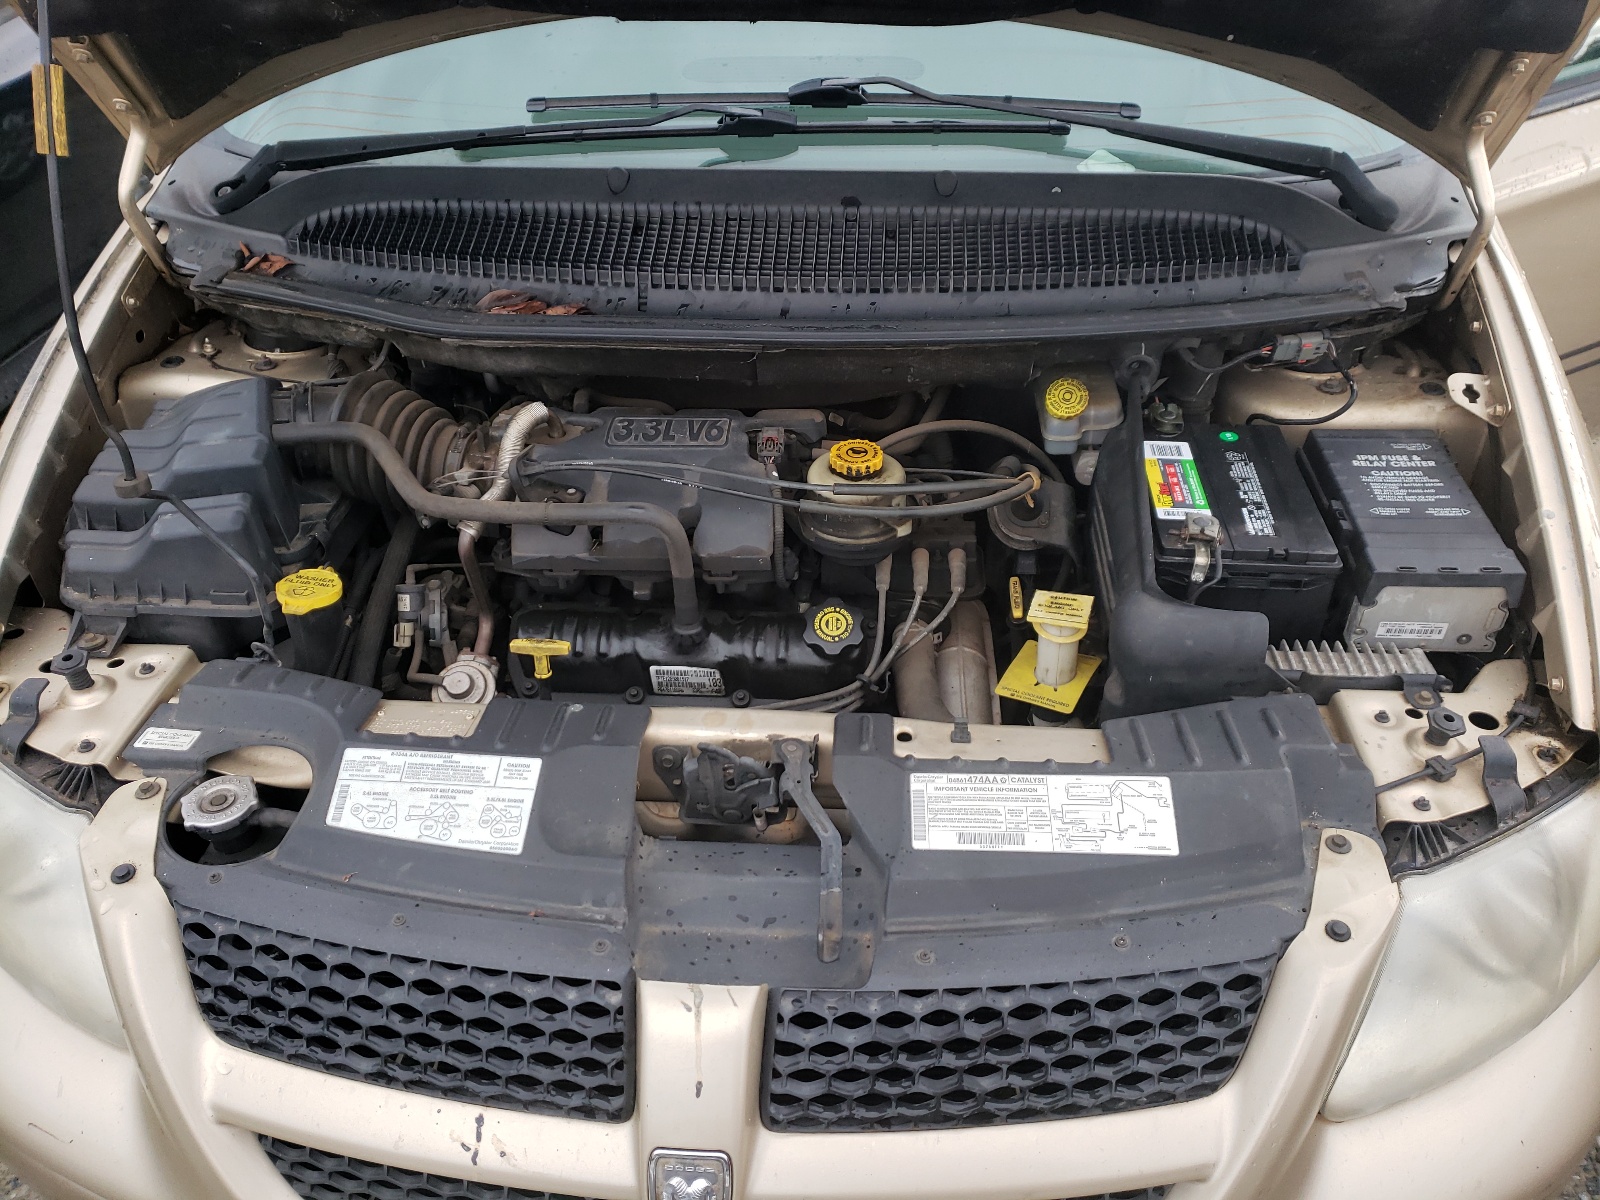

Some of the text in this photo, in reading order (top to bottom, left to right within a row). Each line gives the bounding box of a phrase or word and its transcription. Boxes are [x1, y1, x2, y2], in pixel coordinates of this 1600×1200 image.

[613, 418, 725, 443] 3.3L V6
[284, 577, 338, 589] FLUID ONLY
[295, 574, 335, 583] WASHER
